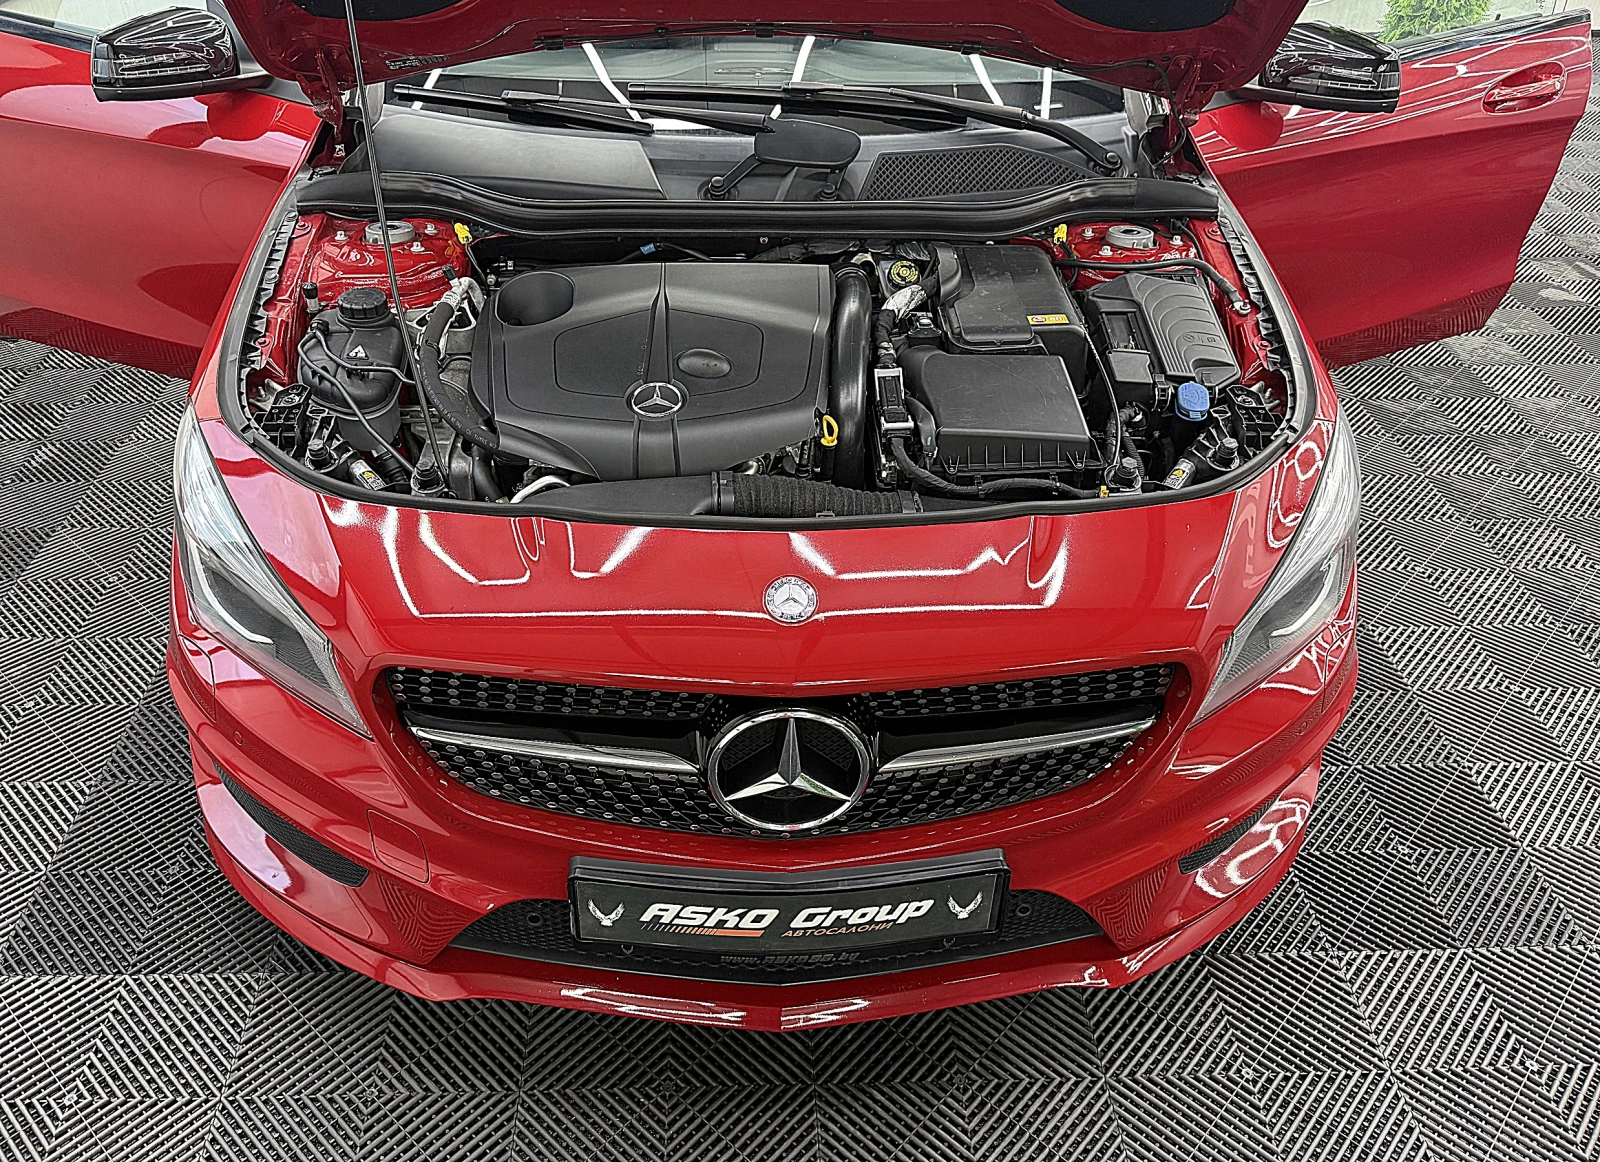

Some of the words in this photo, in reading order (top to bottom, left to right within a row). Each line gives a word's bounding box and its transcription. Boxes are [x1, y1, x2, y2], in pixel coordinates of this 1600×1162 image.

[639, 903, 780, 929] ASKO
[789, 899, 935, 928] Group
[781, 921, 894, 937] АВТОСАЛОНИ
